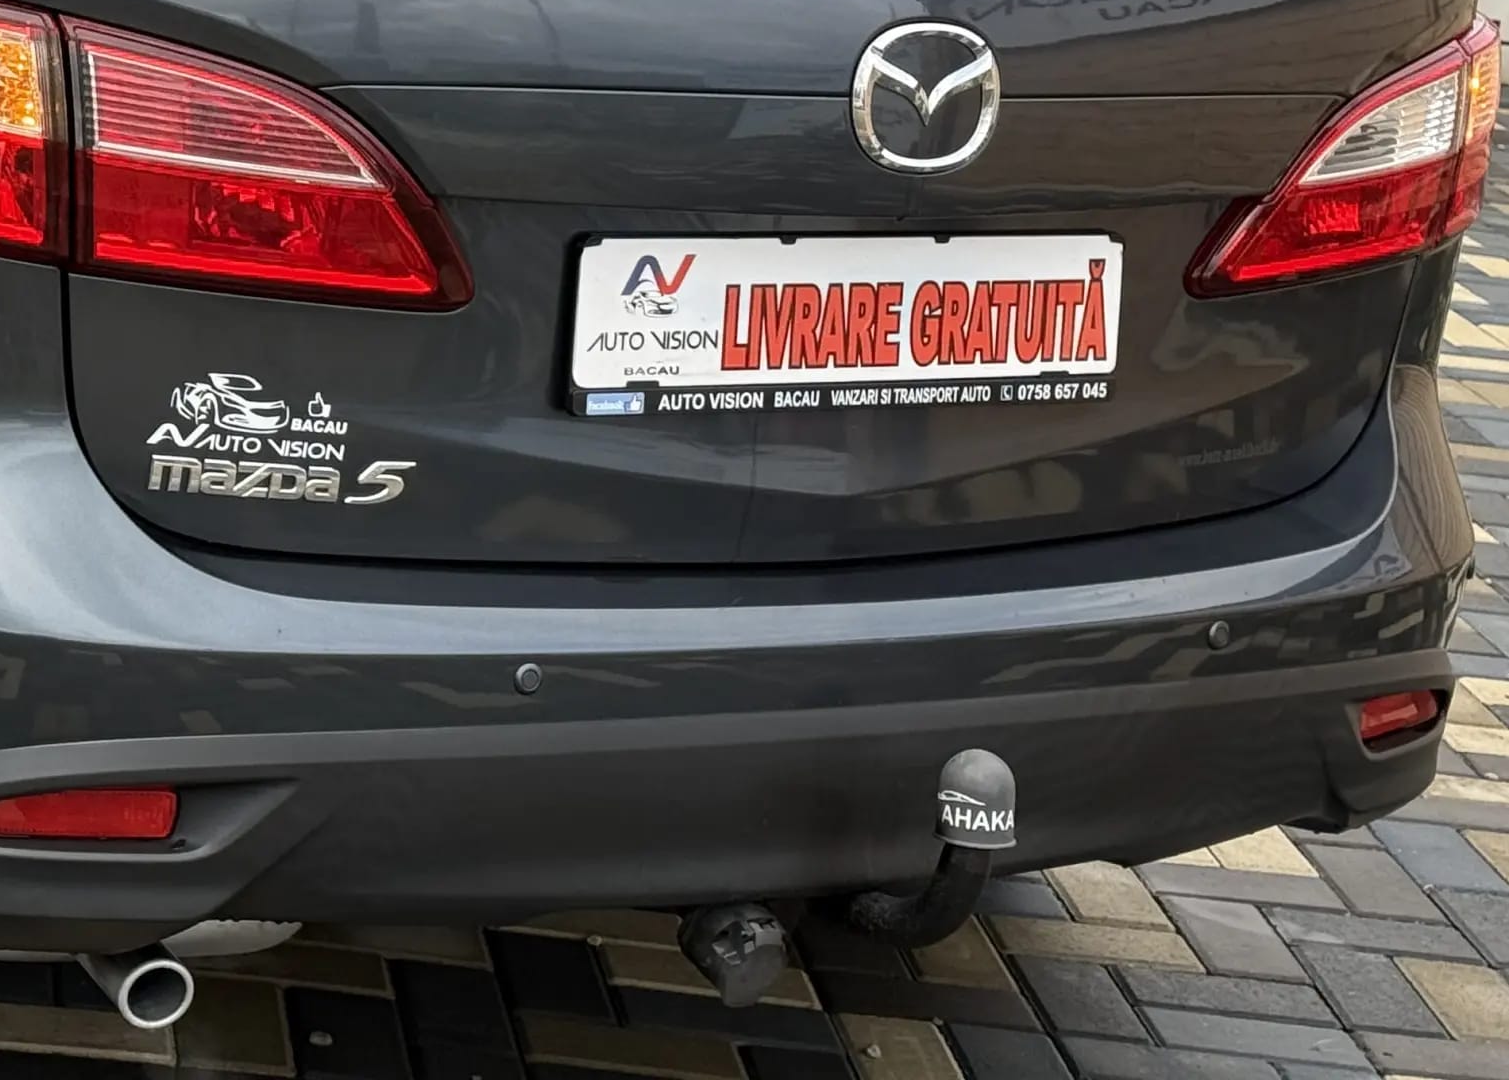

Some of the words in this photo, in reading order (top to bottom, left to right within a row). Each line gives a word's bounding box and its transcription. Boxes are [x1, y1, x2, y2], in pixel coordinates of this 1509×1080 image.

[721, 282, 904, 370] LIVRARE
[910, 259, 1107, 367] GRATUITĂ
[587, 331, 645, 352] AUTO
[650, 329, 719, 351] VISION
[623, 365, 680, 377] BACAU
[658, 393, 705, 411] AUTO
[710, 391, 764, 409] VISION
[774, 390, 820, 407] BACAU
[831, 388, 879, 406] VANZARI
[880, 388, 892, 404] SI
[894, 385, 960, 404] TRANSPORT
[960, 386, 992, 403] AUTO
[1017, 384, 1051, 401] 0758
[1054, 383, 1079, 400] 657
[1082, 382, 1108, 398] 045
[290, 418, 348, 435] BACAU
[194, 434, 262, 454] AUTO
[267, 438, 345, 461] VISION
[147, 454, 341, 503] mazda
[343, 460, 417, 504] 5
[942, 804, 1015, 832] AHAKA
